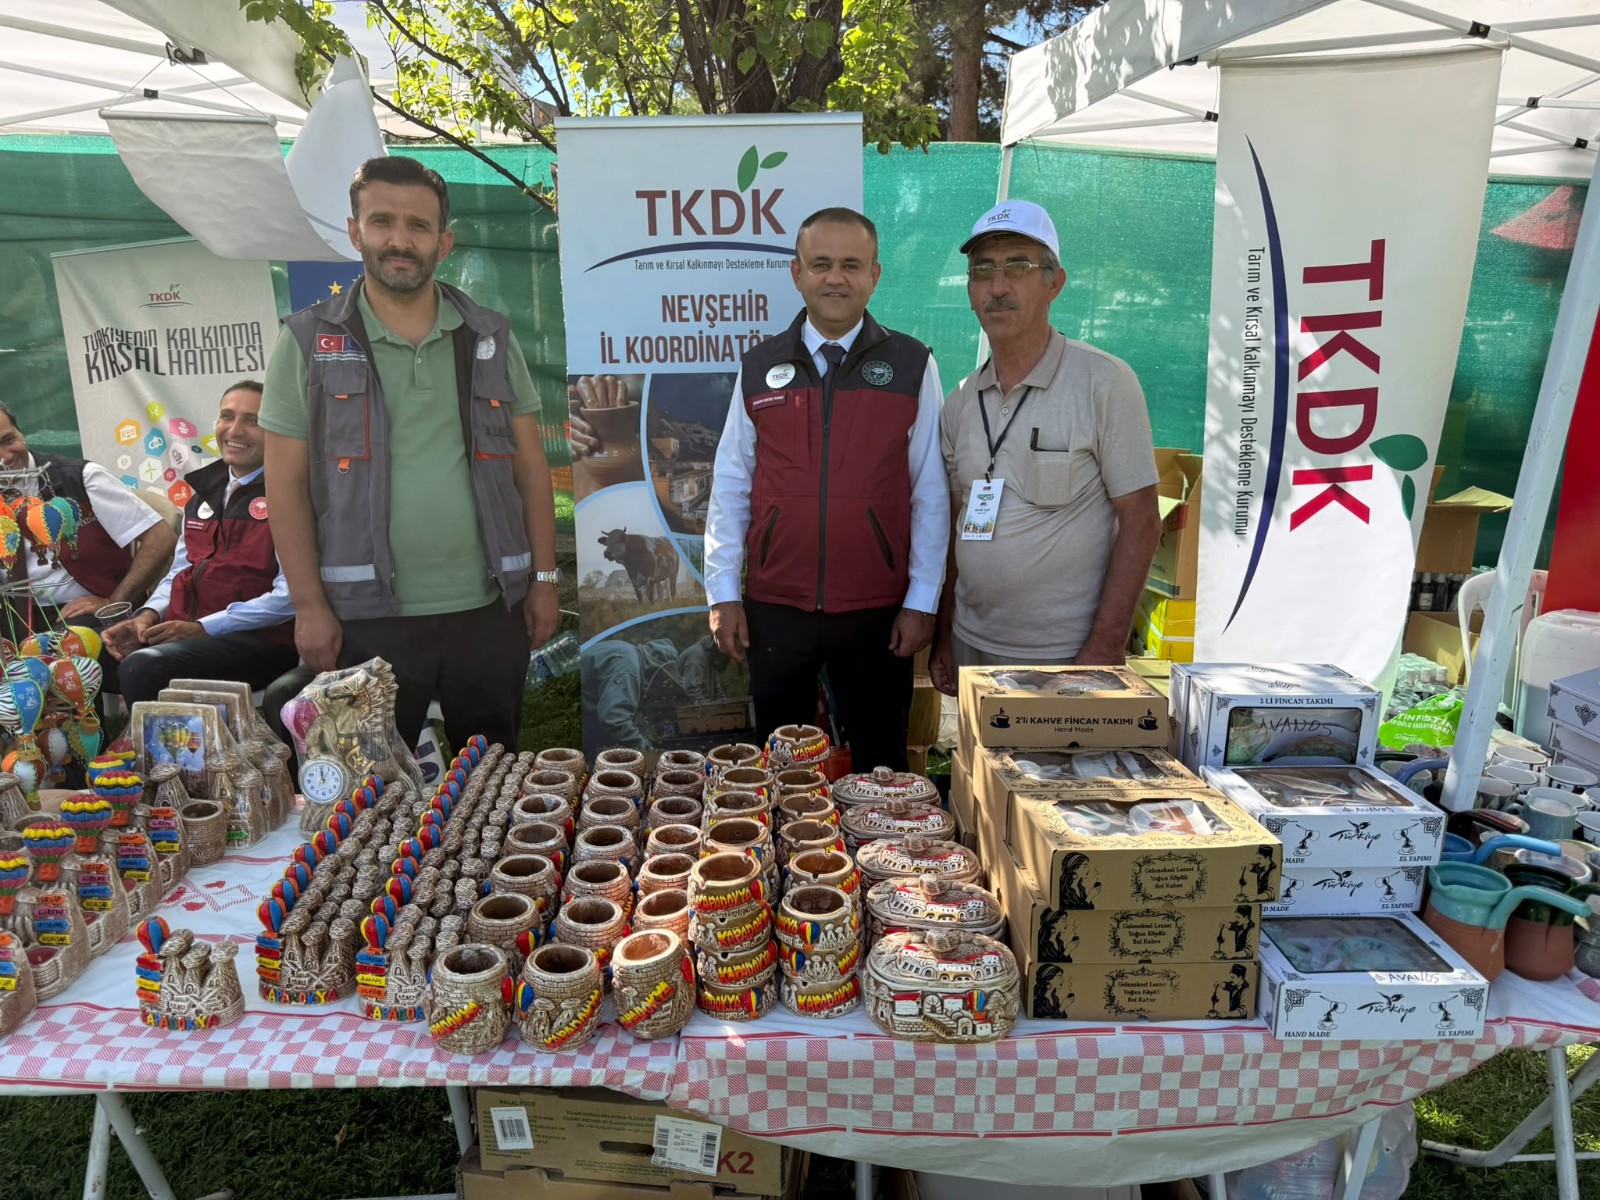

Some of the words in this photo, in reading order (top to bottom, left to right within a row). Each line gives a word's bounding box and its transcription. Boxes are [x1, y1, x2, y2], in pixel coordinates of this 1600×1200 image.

[635, 188, 786, 236] TKDK
[635, 259, 654, 270] Tarım
[655, 261, 664, 270] ve
[666, 259, 685, 270] Kırsal
[726, 258, 764, 270] Destekleme
[1247, 247, 1265, 283] Tarım
[148, 291, 181, 302] TKDK
[661, 289, 769, 328] NEVŞEHİR
[1246, 287, 1260, 302] ve
[1245, 306, 1262, 342] Kırsal
[85, 342, 166, 384] KIRSAL
[600, 331, 620, 364] İL
[625, 330, 774, 364] KOORDİNATÖ
[1238, 346, 1261, 412] Kalkınmayı
[1289, 239, 1385, 532] TKDK
[1238, 417, 1258, 486] Destekleme
[1234, 491, 1254, 535] Kurumu
[1030, 717, 1062, 725] KAHVE
[1064, 715, 1099, 725] FİNCAN
[1101, 717, 1133, 725] TAKIMI
[1329, 824, 1381, 849] Türkiye
[1357, 996, 1416, 1023] Türkiye
